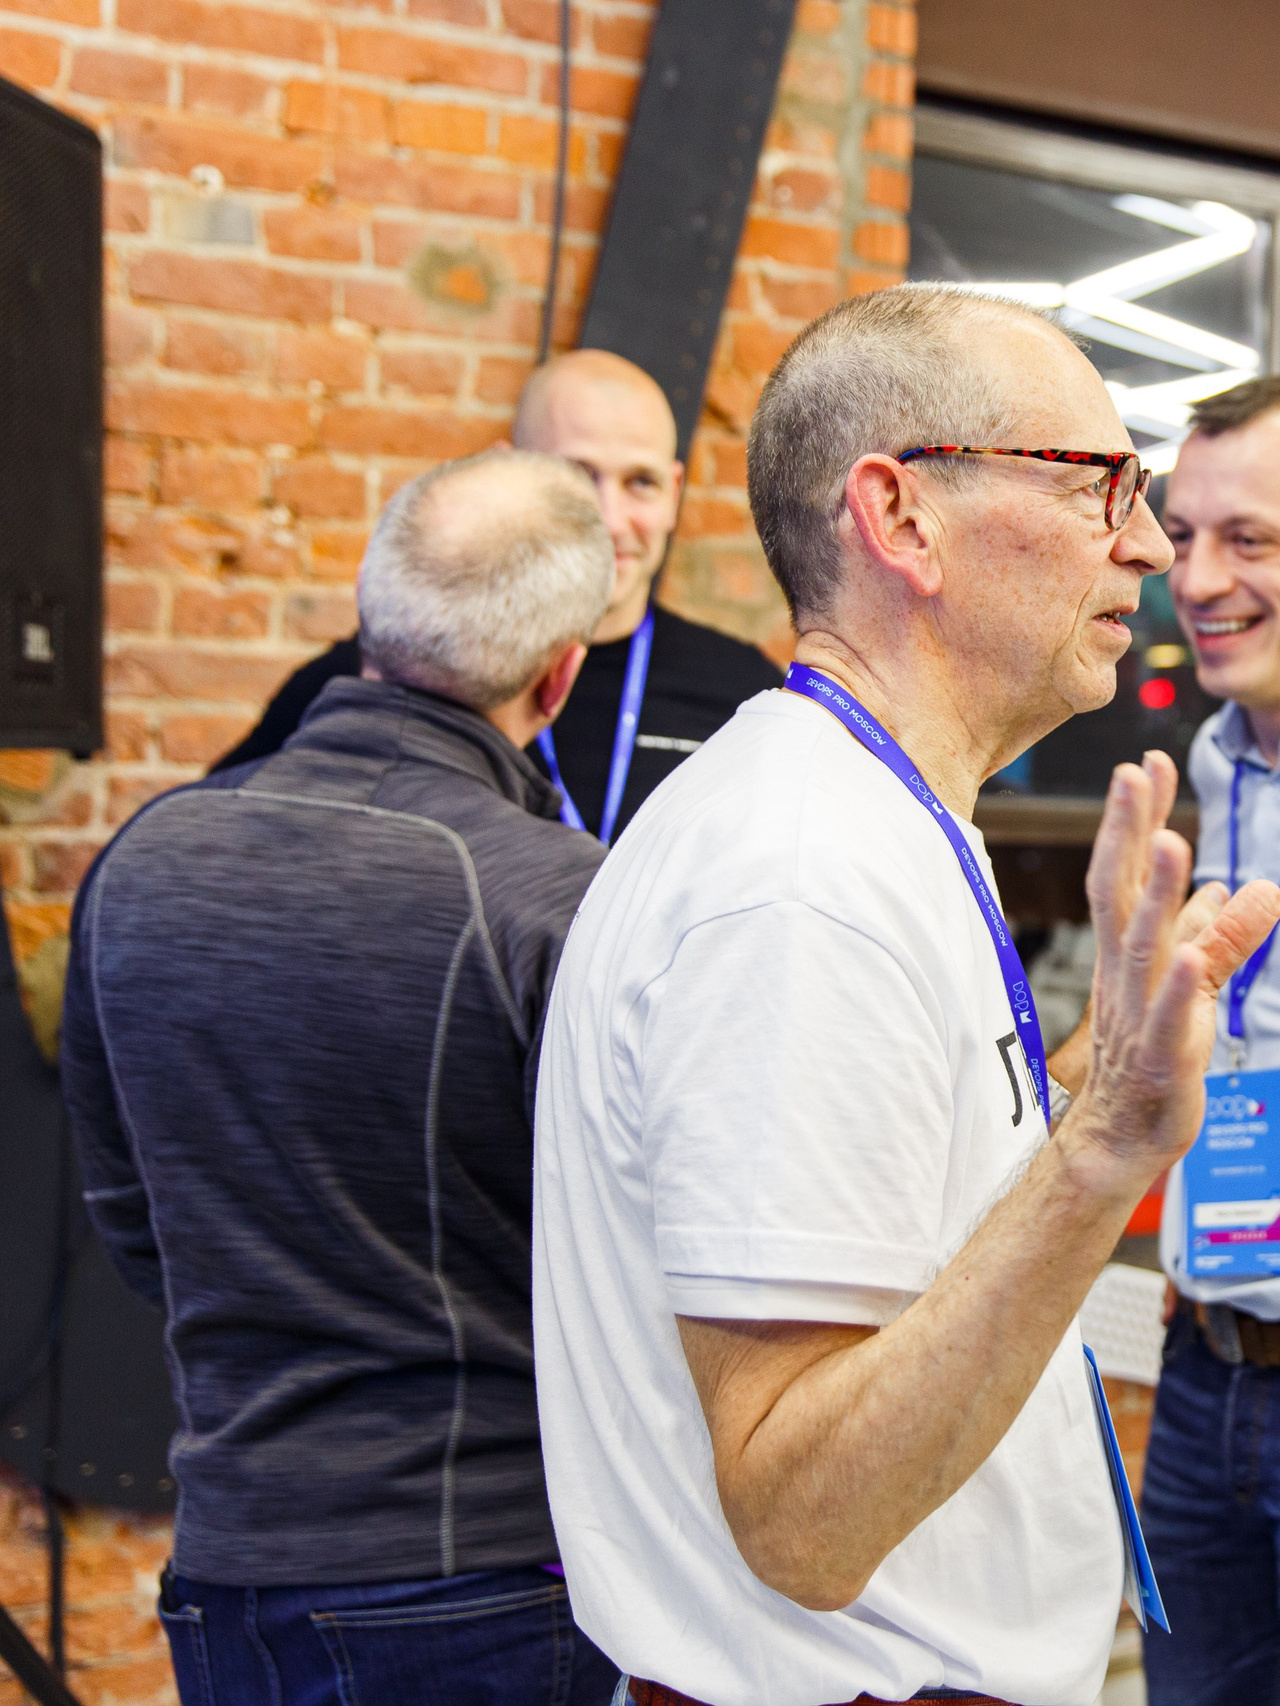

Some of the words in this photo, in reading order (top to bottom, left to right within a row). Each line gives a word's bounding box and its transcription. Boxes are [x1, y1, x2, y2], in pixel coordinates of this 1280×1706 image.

[806, 677, 834, 697] DEVOPS
[832, 694, 850, 711] PRO
[848, 709, 887, 746] MOSCOW
[961, 847, 980, 884] DEVOPS
[979, 884, 990, 903] PRO
[988, 904, 1008, 947] MOSCOW
[1030, 1058, 1043, 1092] DEVOPS
